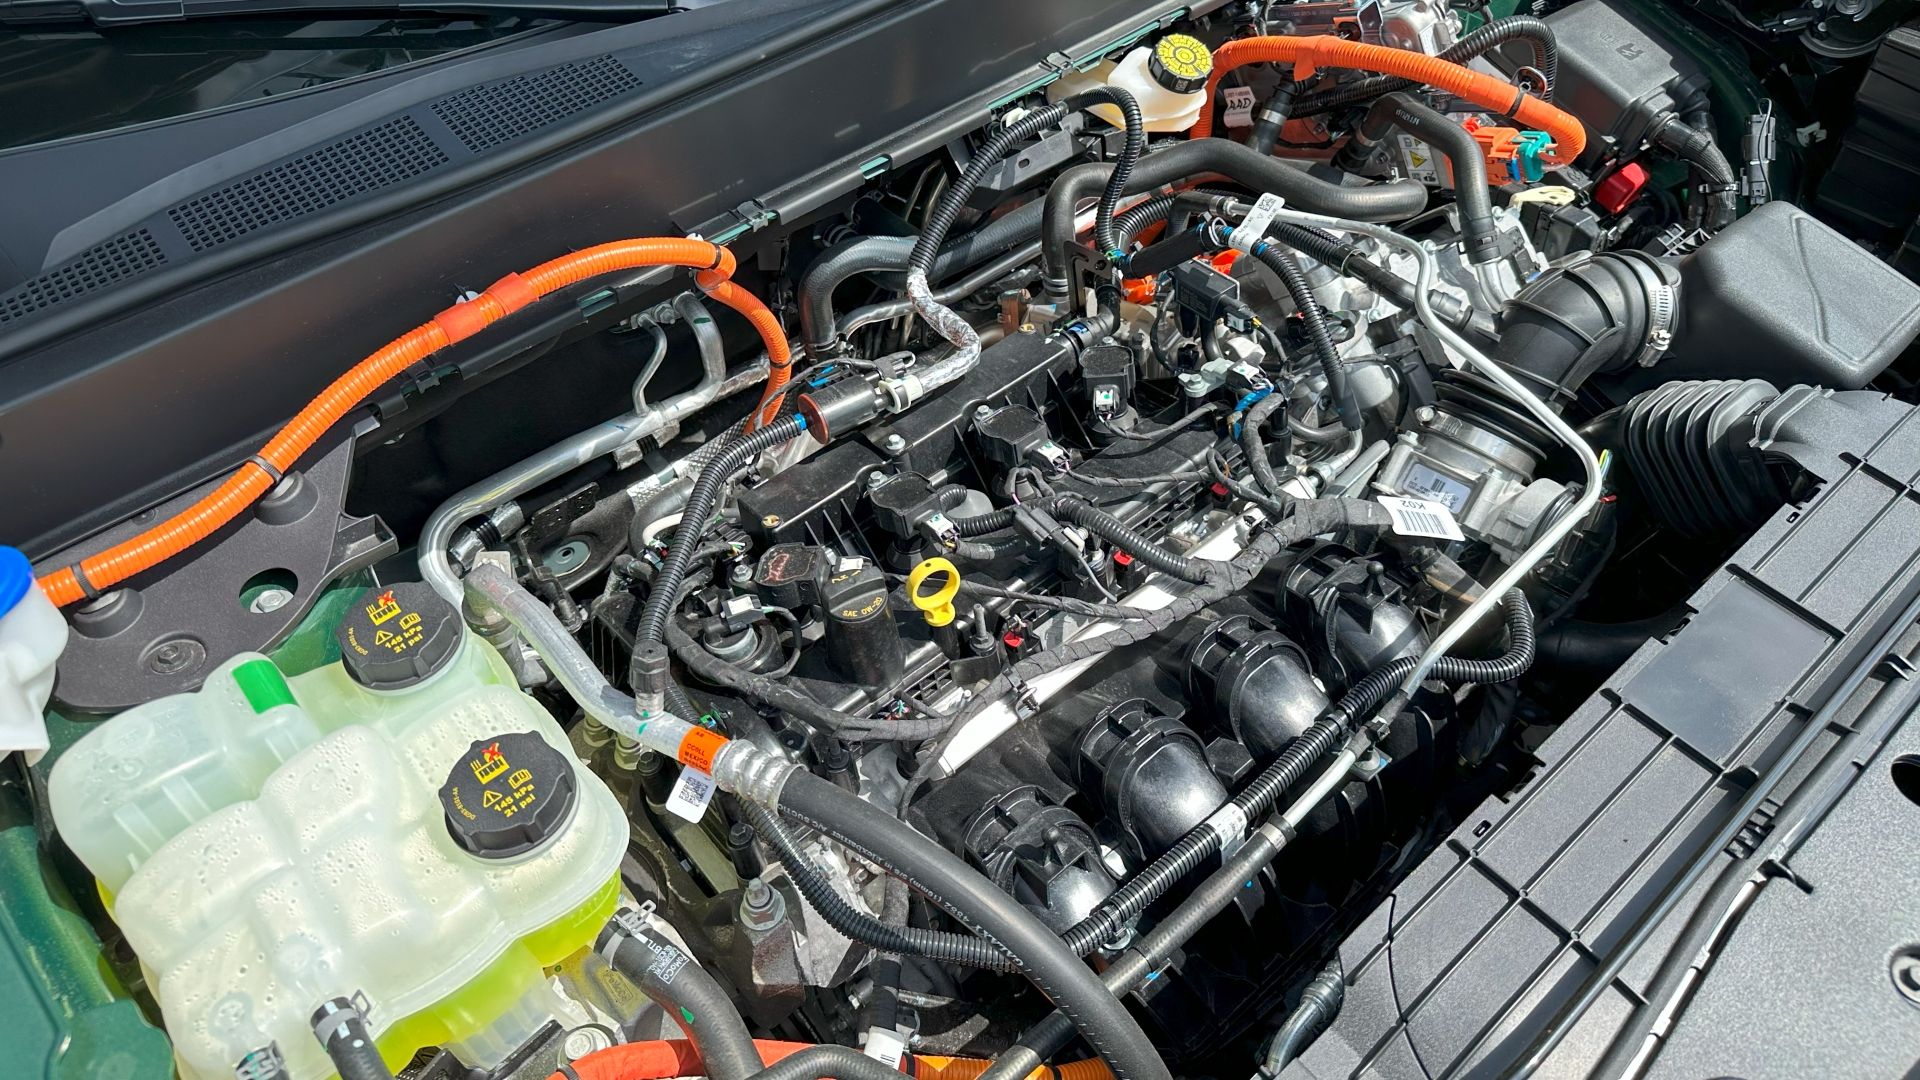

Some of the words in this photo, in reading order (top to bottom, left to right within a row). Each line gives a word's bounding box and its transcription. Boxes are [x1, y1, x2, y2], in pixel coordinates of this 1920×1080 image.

[1400, 500, 1426, 511] K02
[385, 635, 403, 649] 145
[403, 625, 423, 639] kPa
[393, 642, 407, 654] 21
[408, 633, 423, 647] psi
[494, 796, 514, 812] 145
[513, 783, 535, 799] kPa
[503, 804, 518, 818] 21
[519, 793, 536, 809] psi
[777, 803, 810, 824] SUCTIO
[944, 901, 970, 922] 4882
[975, 924, 1024, 966] GALAXY
[663, 954, 688, 980] FoMoCo
